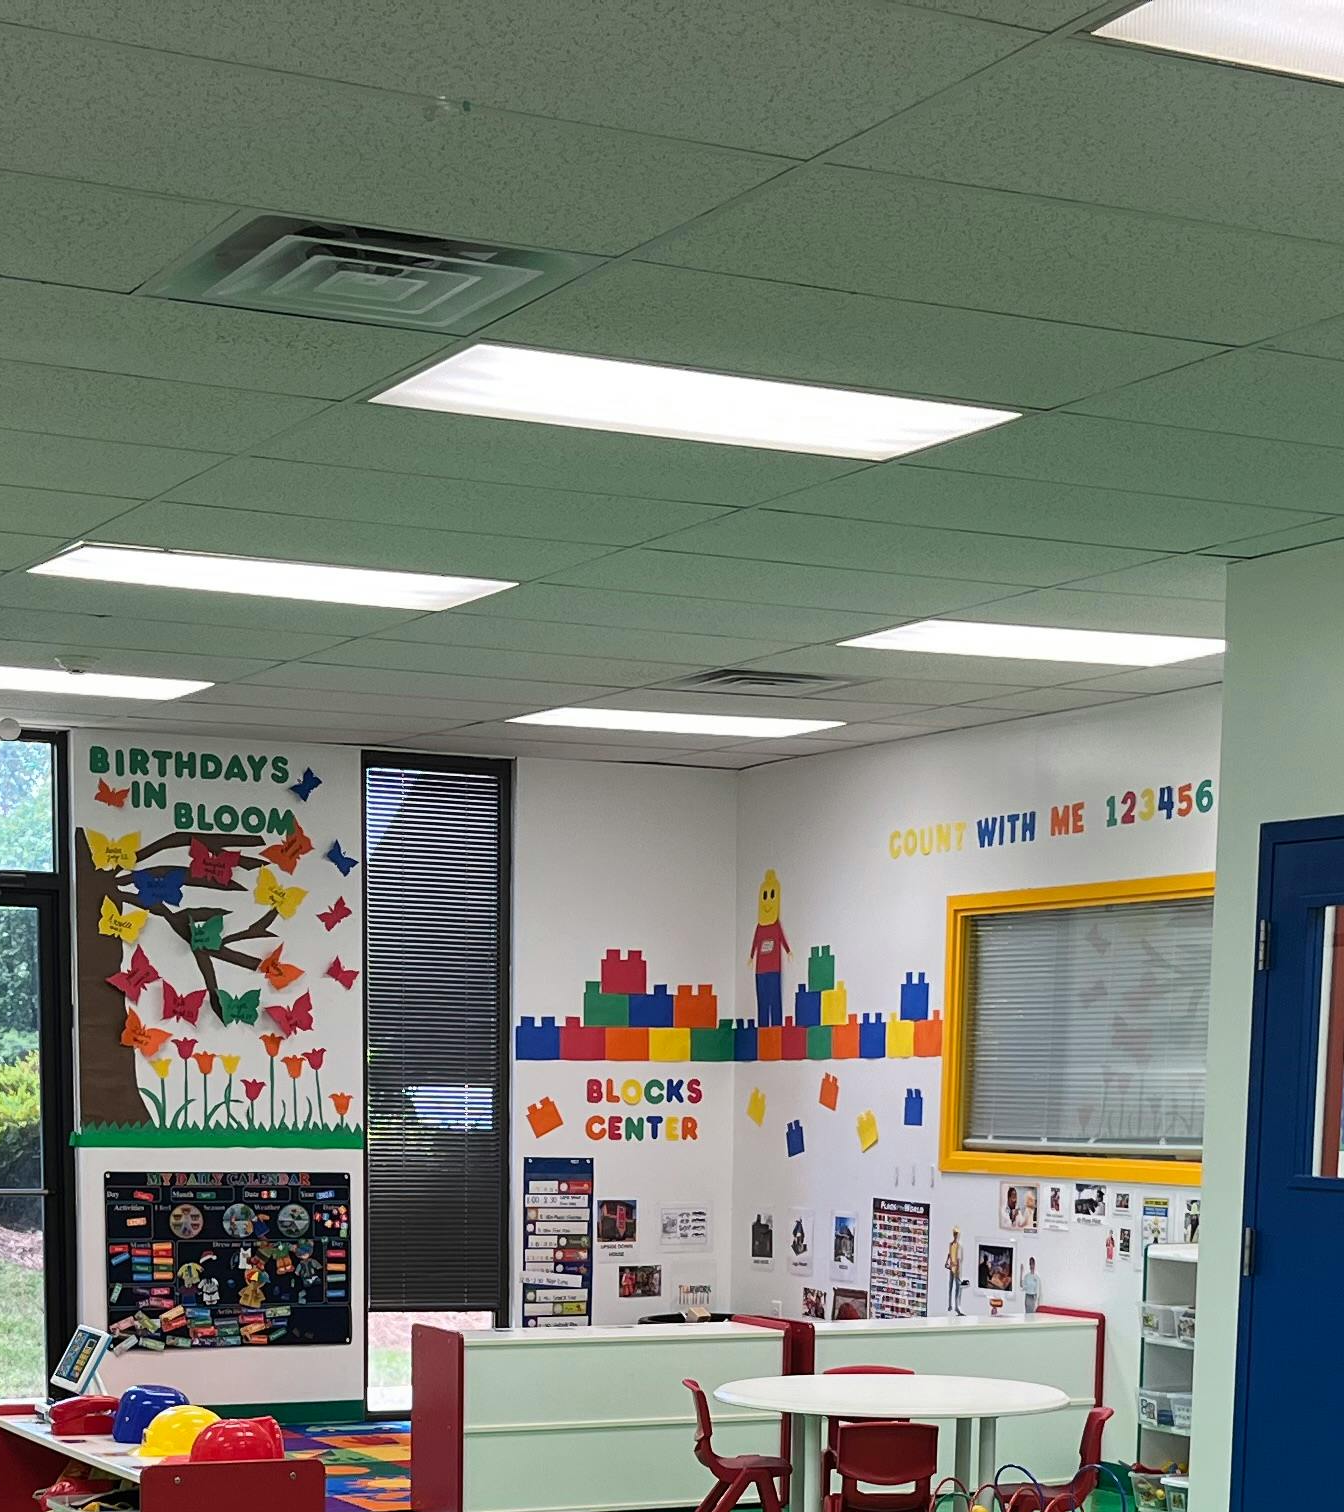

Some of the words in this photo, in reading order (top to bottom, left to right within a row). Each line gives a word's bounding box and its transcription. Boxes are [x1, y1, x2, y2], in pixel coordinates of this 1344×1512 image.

[88, 745, 289, 784] BIRTHDAYS
[130, 780, 168, 810] IN
[173, 801, 295, 836] BLOOM
[889, 822, 966, 860] COUNT
[976, 811, 1037, 849] WITH
[1050, 801, 1085, 837] ME
[586, 1078, 703, 1105] BLOCKS
[585, 1115, 698, 1141] CENTER
[147, 1173, 172, 1186] MY
[175, 1173, 224, 1186] DAILY
[226, 1173, 311, 1186] CALENDAR
[106, 1191, 119, 1199] Day
[301, 1190, 314, 1198] Year
